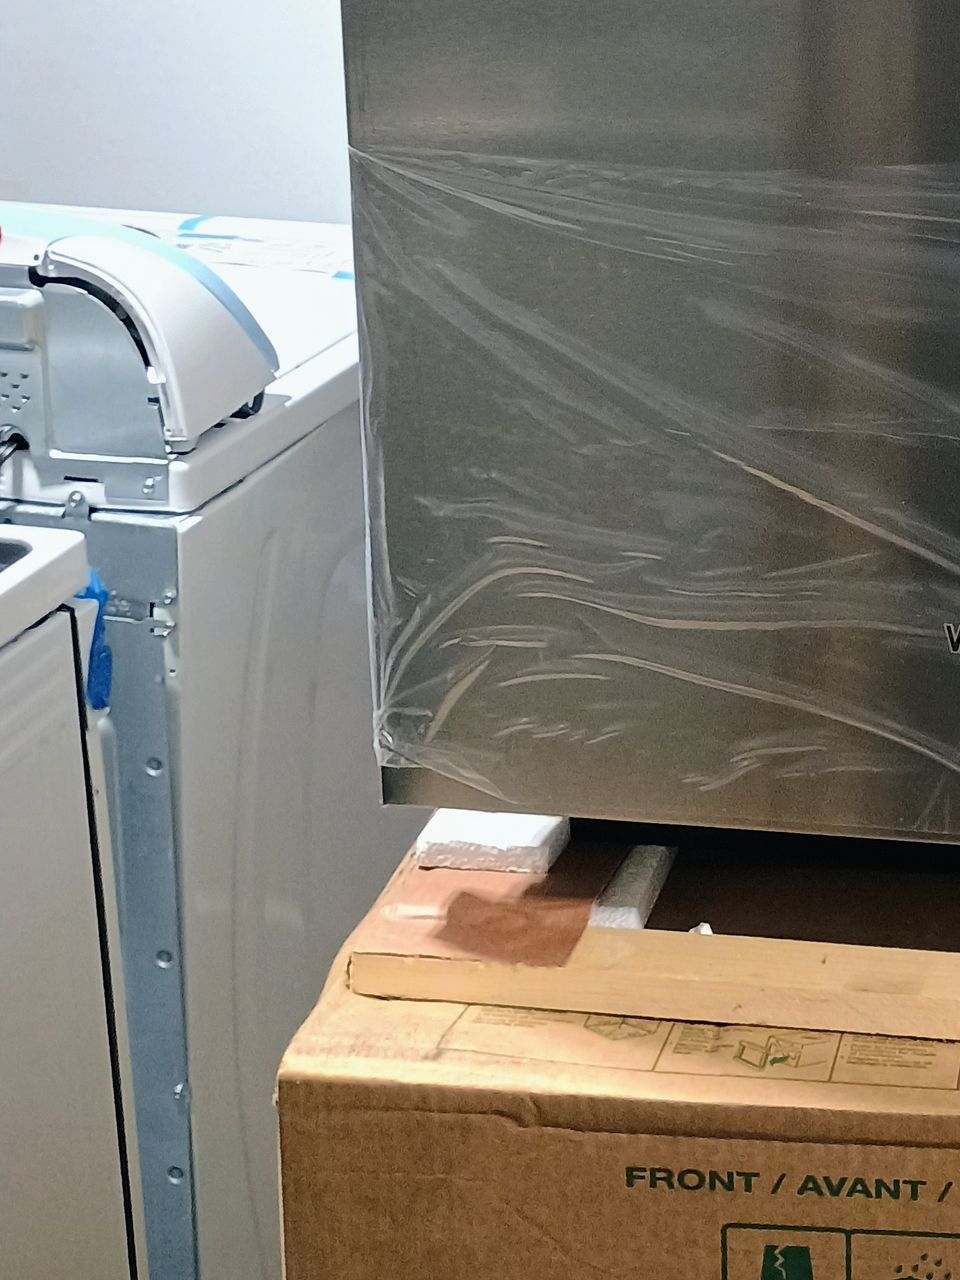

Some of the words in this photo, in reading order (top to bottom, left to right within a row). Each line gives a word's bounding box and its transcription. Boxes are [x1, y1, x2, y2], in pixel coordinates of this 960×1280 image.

[625, 1167, 760, 1193] FRONT
[771, 1173, 786, 1195] /
[797, 1174, 927, 1202] AVANT
[937, 1181, 953, 1203] /
